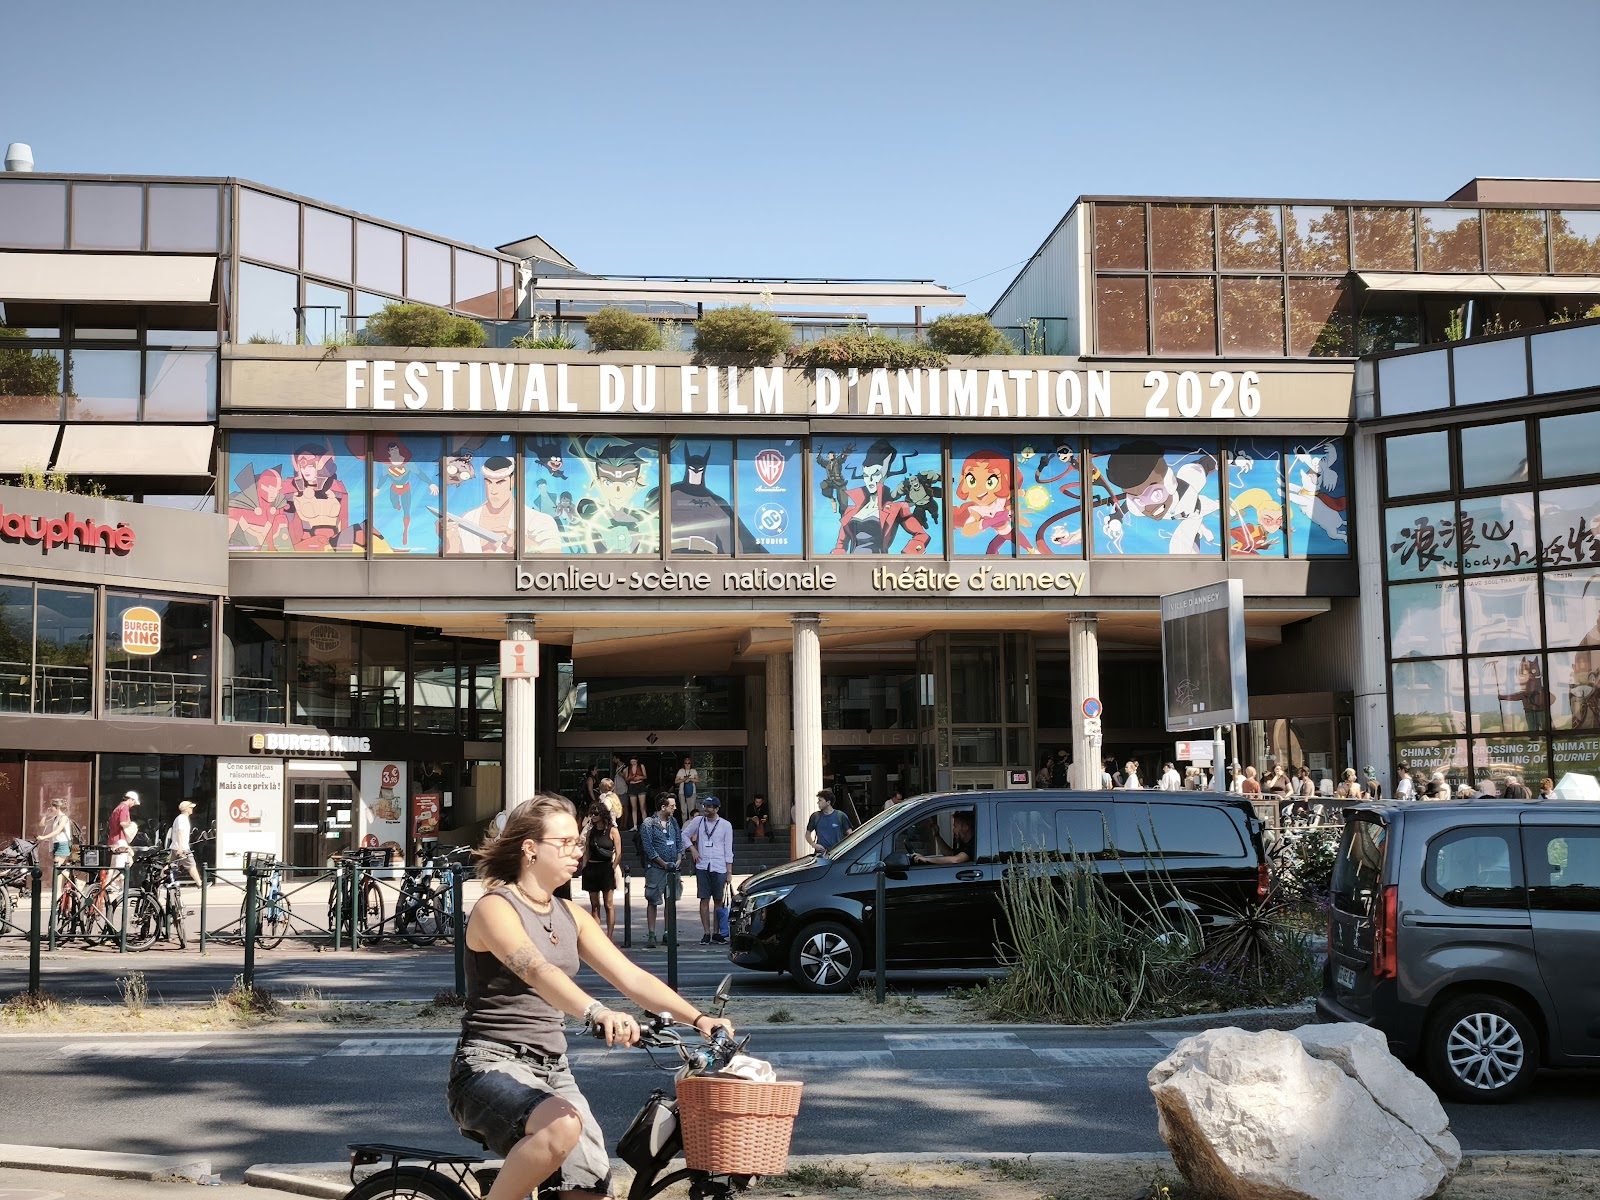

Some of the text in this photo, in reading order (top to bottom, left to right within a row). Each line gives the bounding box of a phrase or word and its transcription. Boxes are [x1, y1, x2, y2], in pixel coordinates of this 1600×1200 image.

[345, 360, 1261, 418] FESTIVAL DU FILM D'ANIMATION 2026
[762, 511, 780, 528] DC
[1442, 555, 1501, 570] Nobody
[515, 565, 837, 591] bonlieu-scène nationale
[872, 565, 1088, 596] théâtre d'annecy
[1170, 592, 1220, 610] VILLE D'ANNECY
[124, 621, 159, 631] BURGER
[124, 631, 159, 645] KING
[265, 734, 331, 751] BURGER
[331, 736, 371, 752] KING
[835, 734, 916, 744] ONLIEU
[1400, 747, 1440, 757] CHINA'S
[1472, 743, 1524, 754] GROSSING
[1527, 743, 1540, 752] 2D
[1552, 741, 1600, 751] ANIMATE
[1533, 754, 1547, 764] OF
[1552, 752, 1598, 762] JOURNEY
[219, 782, 236, 790] Mais
[253, 782, 268, 791] prix
